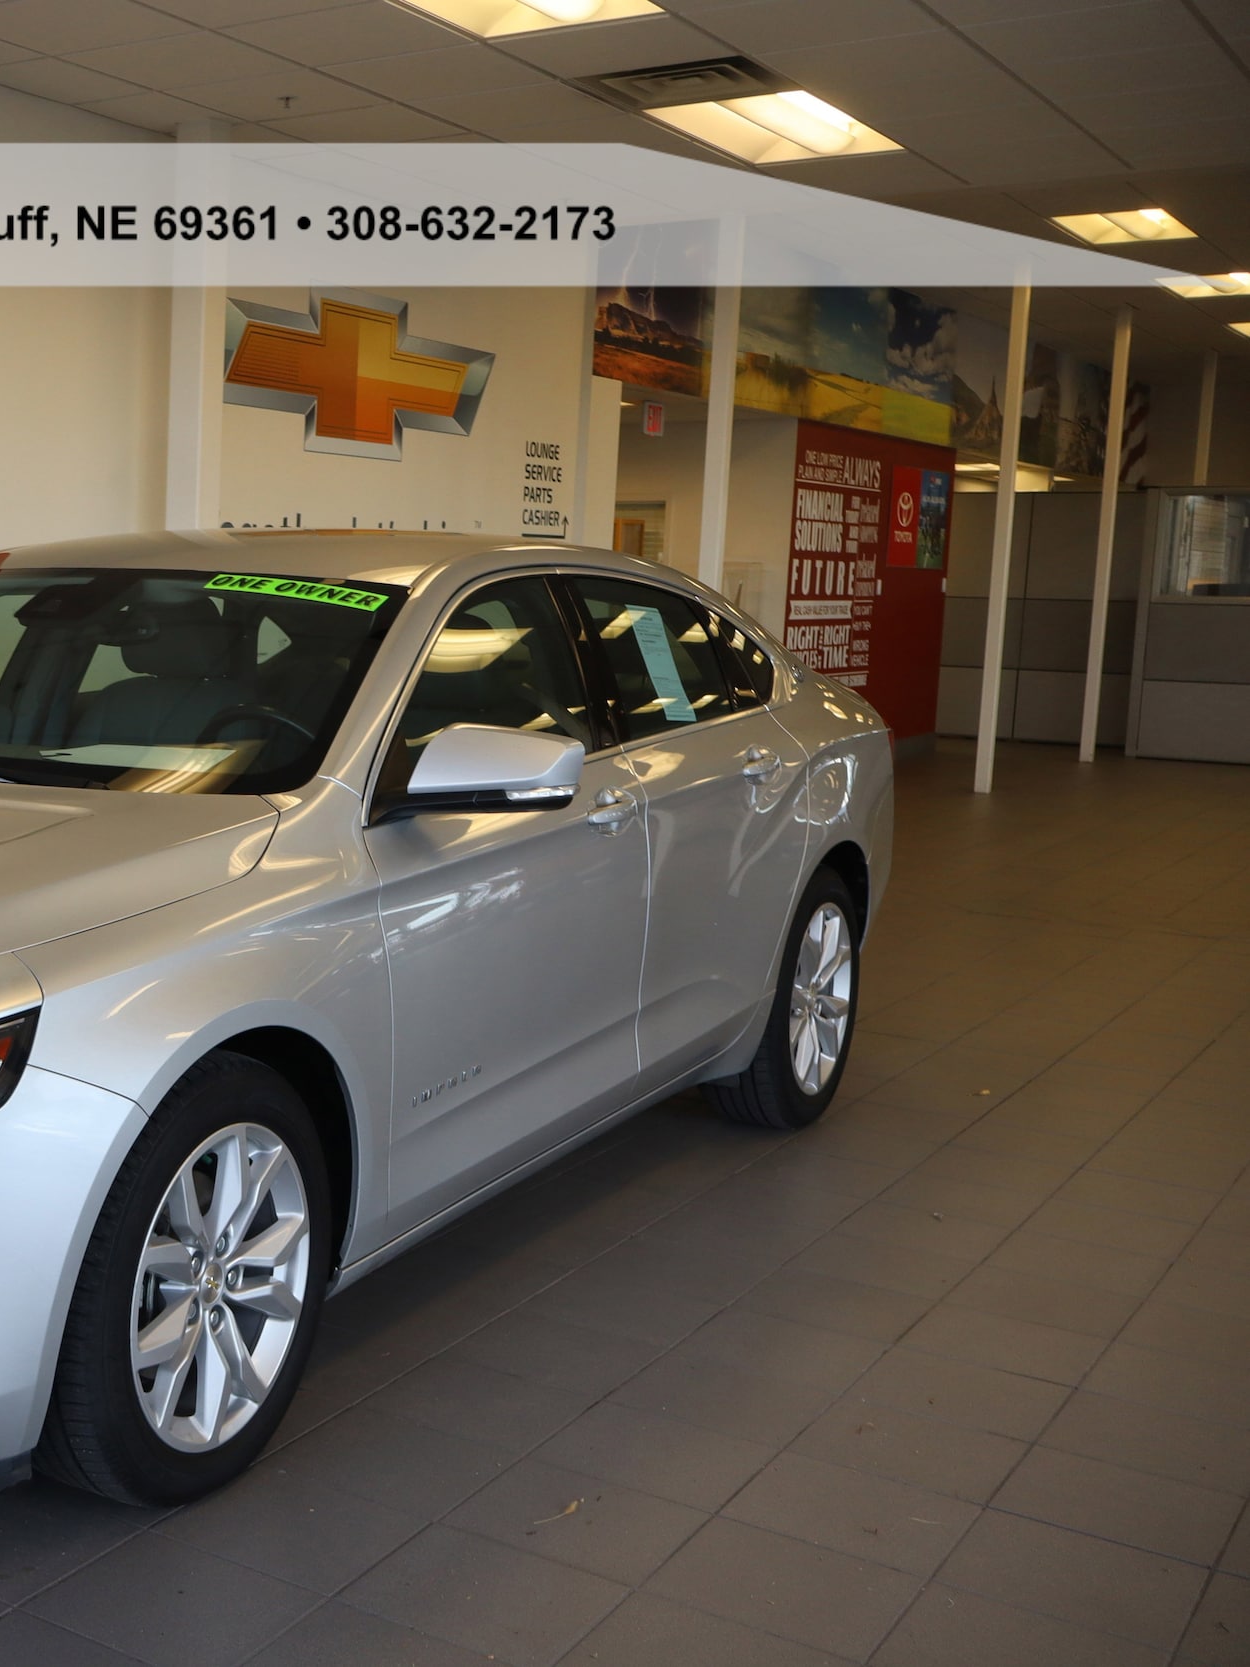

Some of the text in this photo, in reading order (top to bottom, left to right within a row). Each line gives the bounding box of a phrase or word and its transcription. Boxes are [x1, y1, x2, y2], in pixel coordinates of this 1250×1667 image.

[525, 440, 560, 461] LOUNGE
[524, 463, 562, 484] SERVICE
[842, 455, 882, 489] ALWAYS
[522, 486, 553, 505] PARTS
[796, 487, 844, 522] FINANCIAL
[521, 509, 560, 528] CASHIER
[794, 519, 843, 553] SOLUTIONS
[894, 530, 913, 544] TOYOTA
[790, 558, 855, 596] FUTURE
[211, 576, 381, 607] ONE OWNER
[786, 625, 820, 650] RIGHT
[823, 624, 852, 646] RIGHT
[822, 645, 849, 670] TIME
